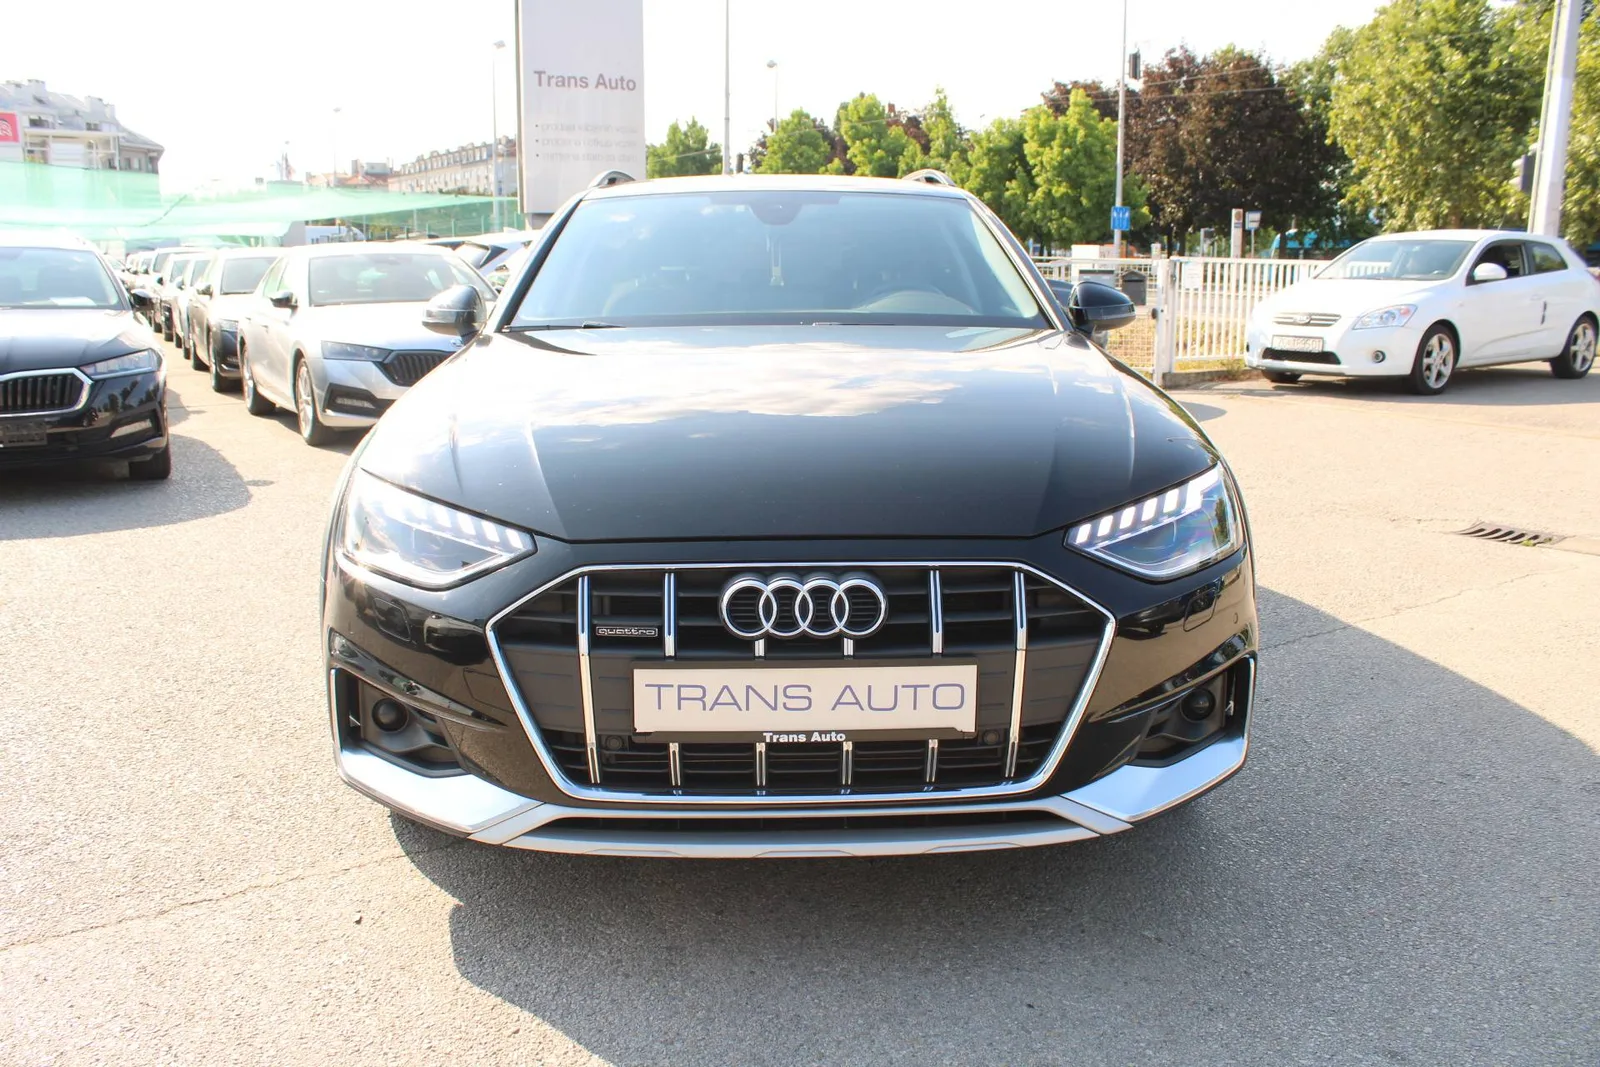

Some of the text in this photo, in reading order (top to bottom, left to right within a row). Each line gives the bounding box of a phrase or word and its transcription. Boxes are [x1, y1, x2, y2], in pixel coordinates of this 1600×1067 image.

[533, 70, 637, 92] Trans Auto
[598, 628, 656, 636] quattro
[645, 682, 965, 711] TRANS AUTO
[763, 730, 846, 743] Trans Auto
